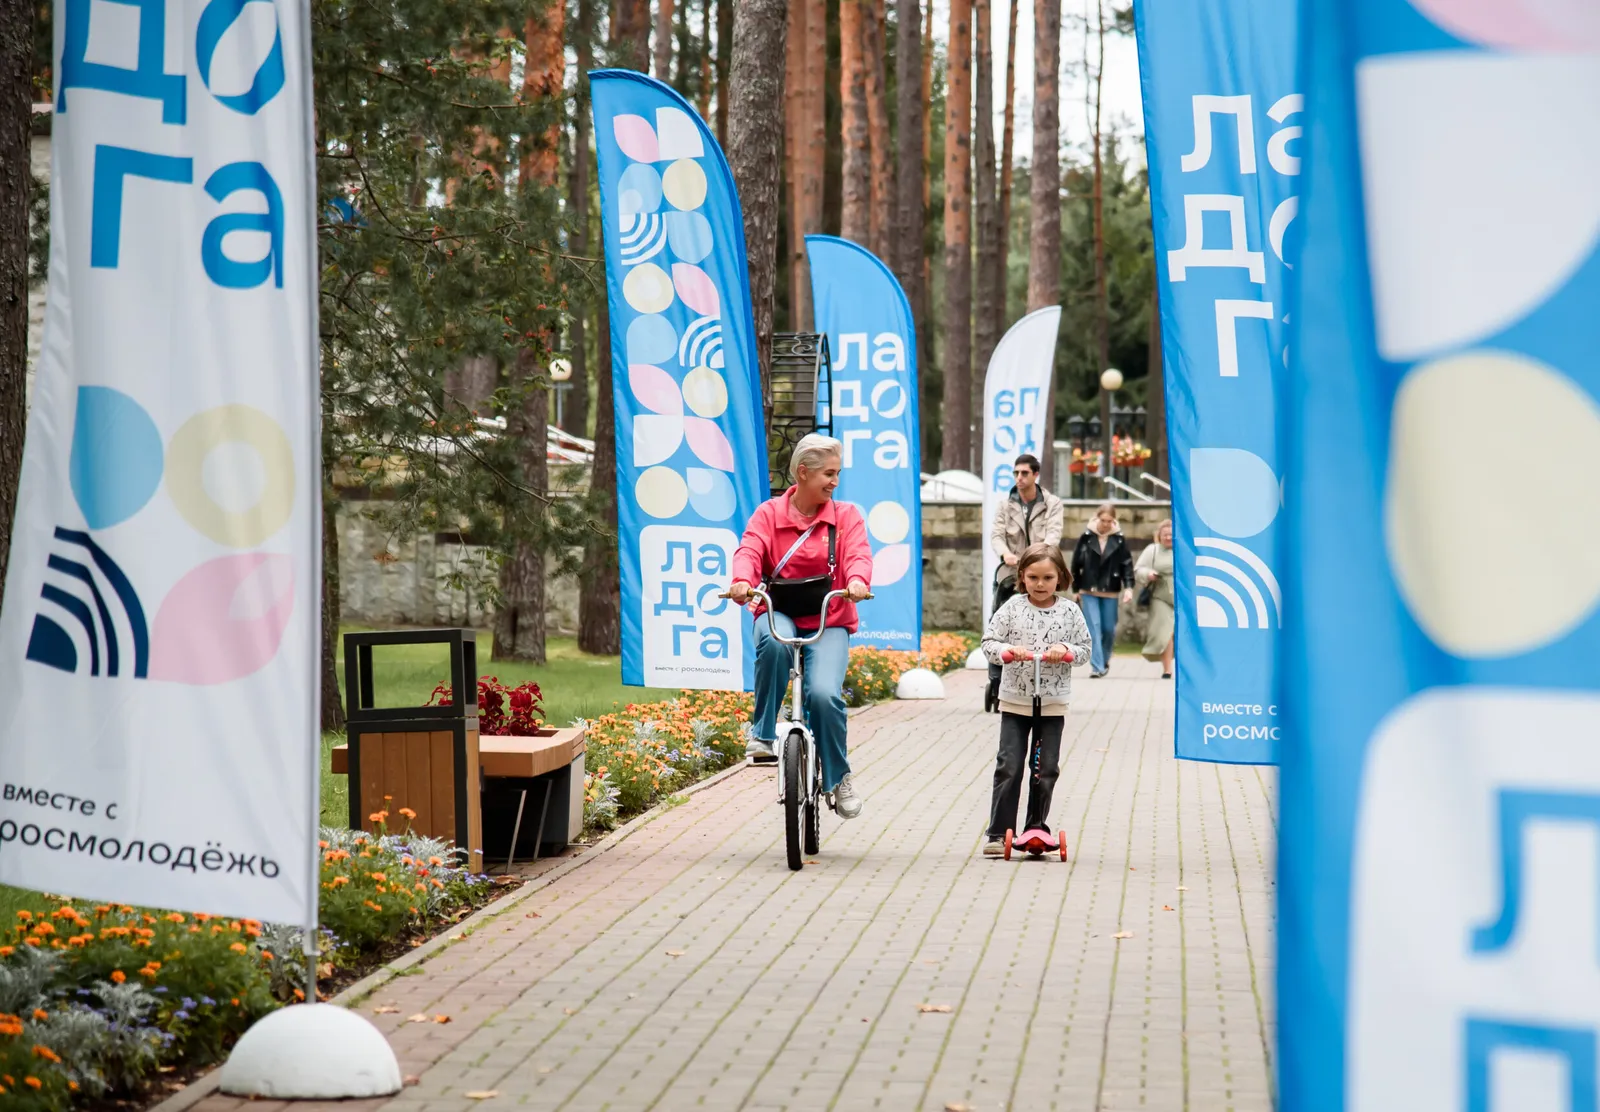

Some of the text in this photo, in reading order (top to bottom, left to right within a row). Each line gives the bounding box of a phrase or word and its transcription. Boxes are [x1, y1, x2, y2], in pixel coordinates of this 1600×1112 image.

[90, 144, 285, 290] га
[832, 332, 905, 372] ла
[823, 379, 907, 422] до
[842, 430, 909, 470] га
[661, 541, 727, 576] ла
[653, 581, 728, 618] до
[672, 624, 729, 659] га
[1202, 702, 1277, 716] вместе с
[3, 783, 118, 820] вместе с
[0, 819, 280, 879] росмолодёжь
